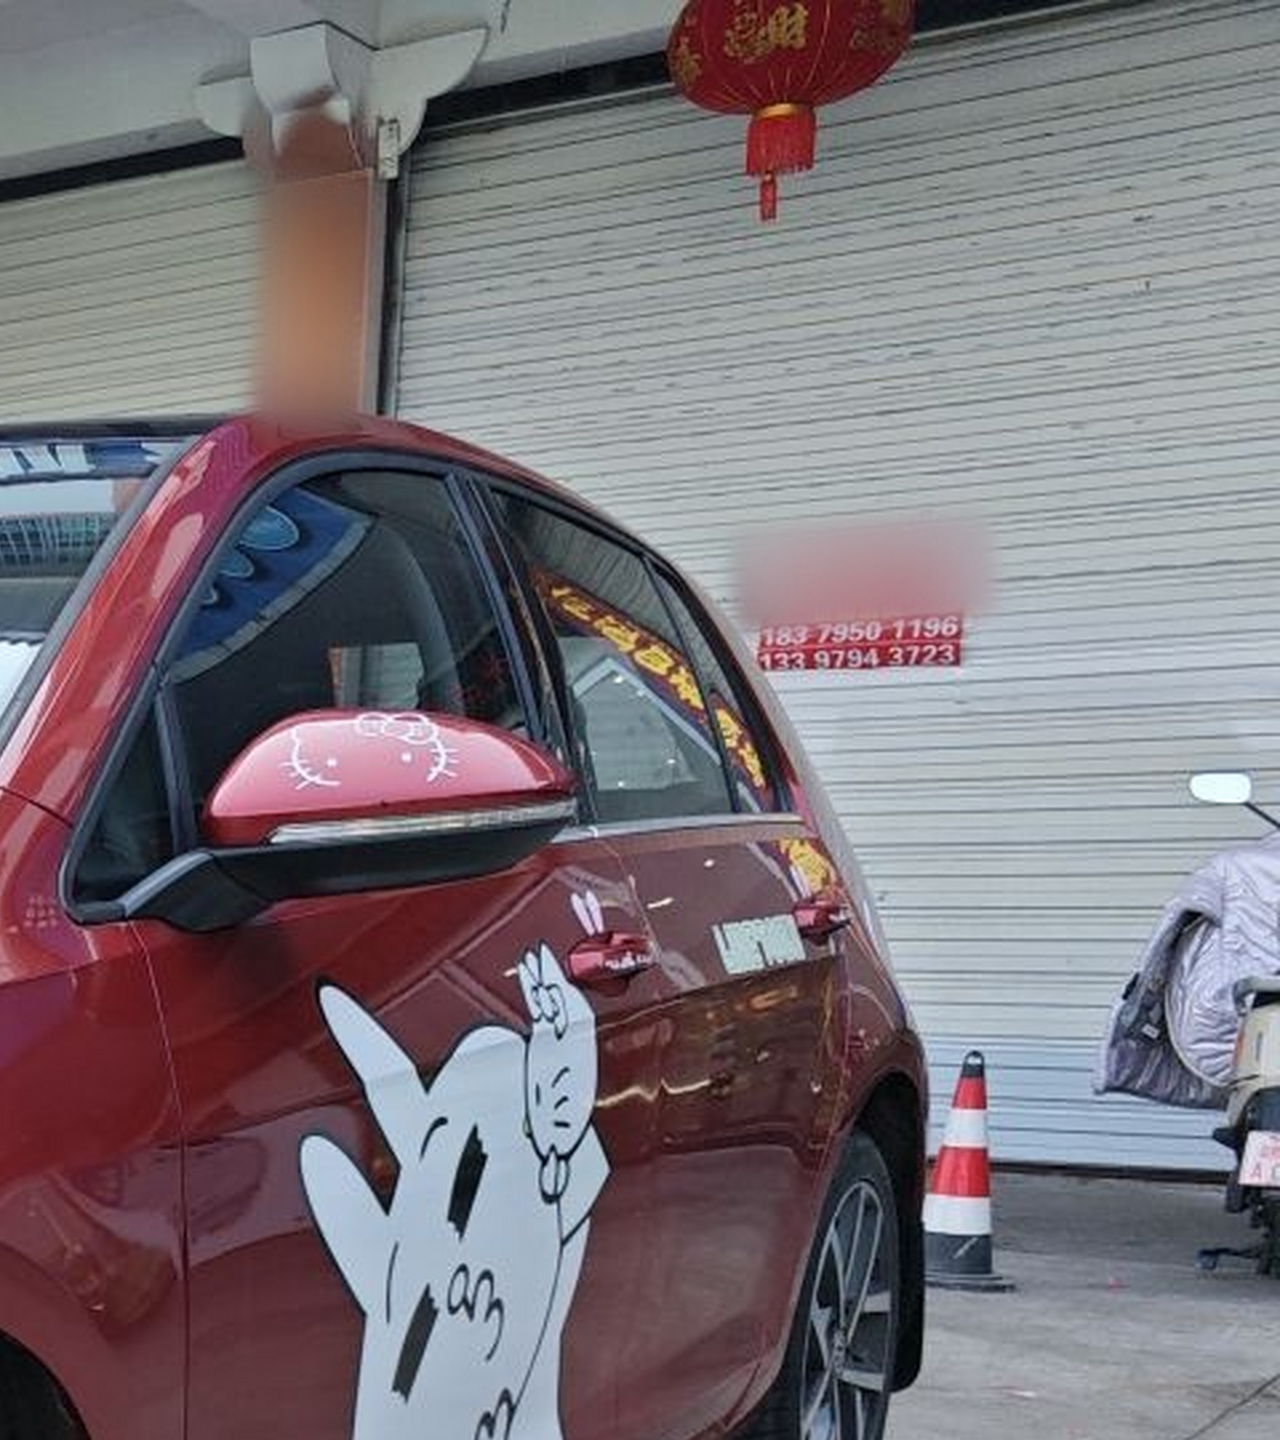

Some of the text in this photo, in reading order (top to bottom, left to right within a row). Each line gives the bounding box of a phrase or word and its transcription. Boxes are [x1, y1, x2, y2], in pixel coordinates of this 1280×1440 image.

[761, 615, 959, 647] 183 7950 1196
[758, 644, 956, 671] 133 9794 3723
